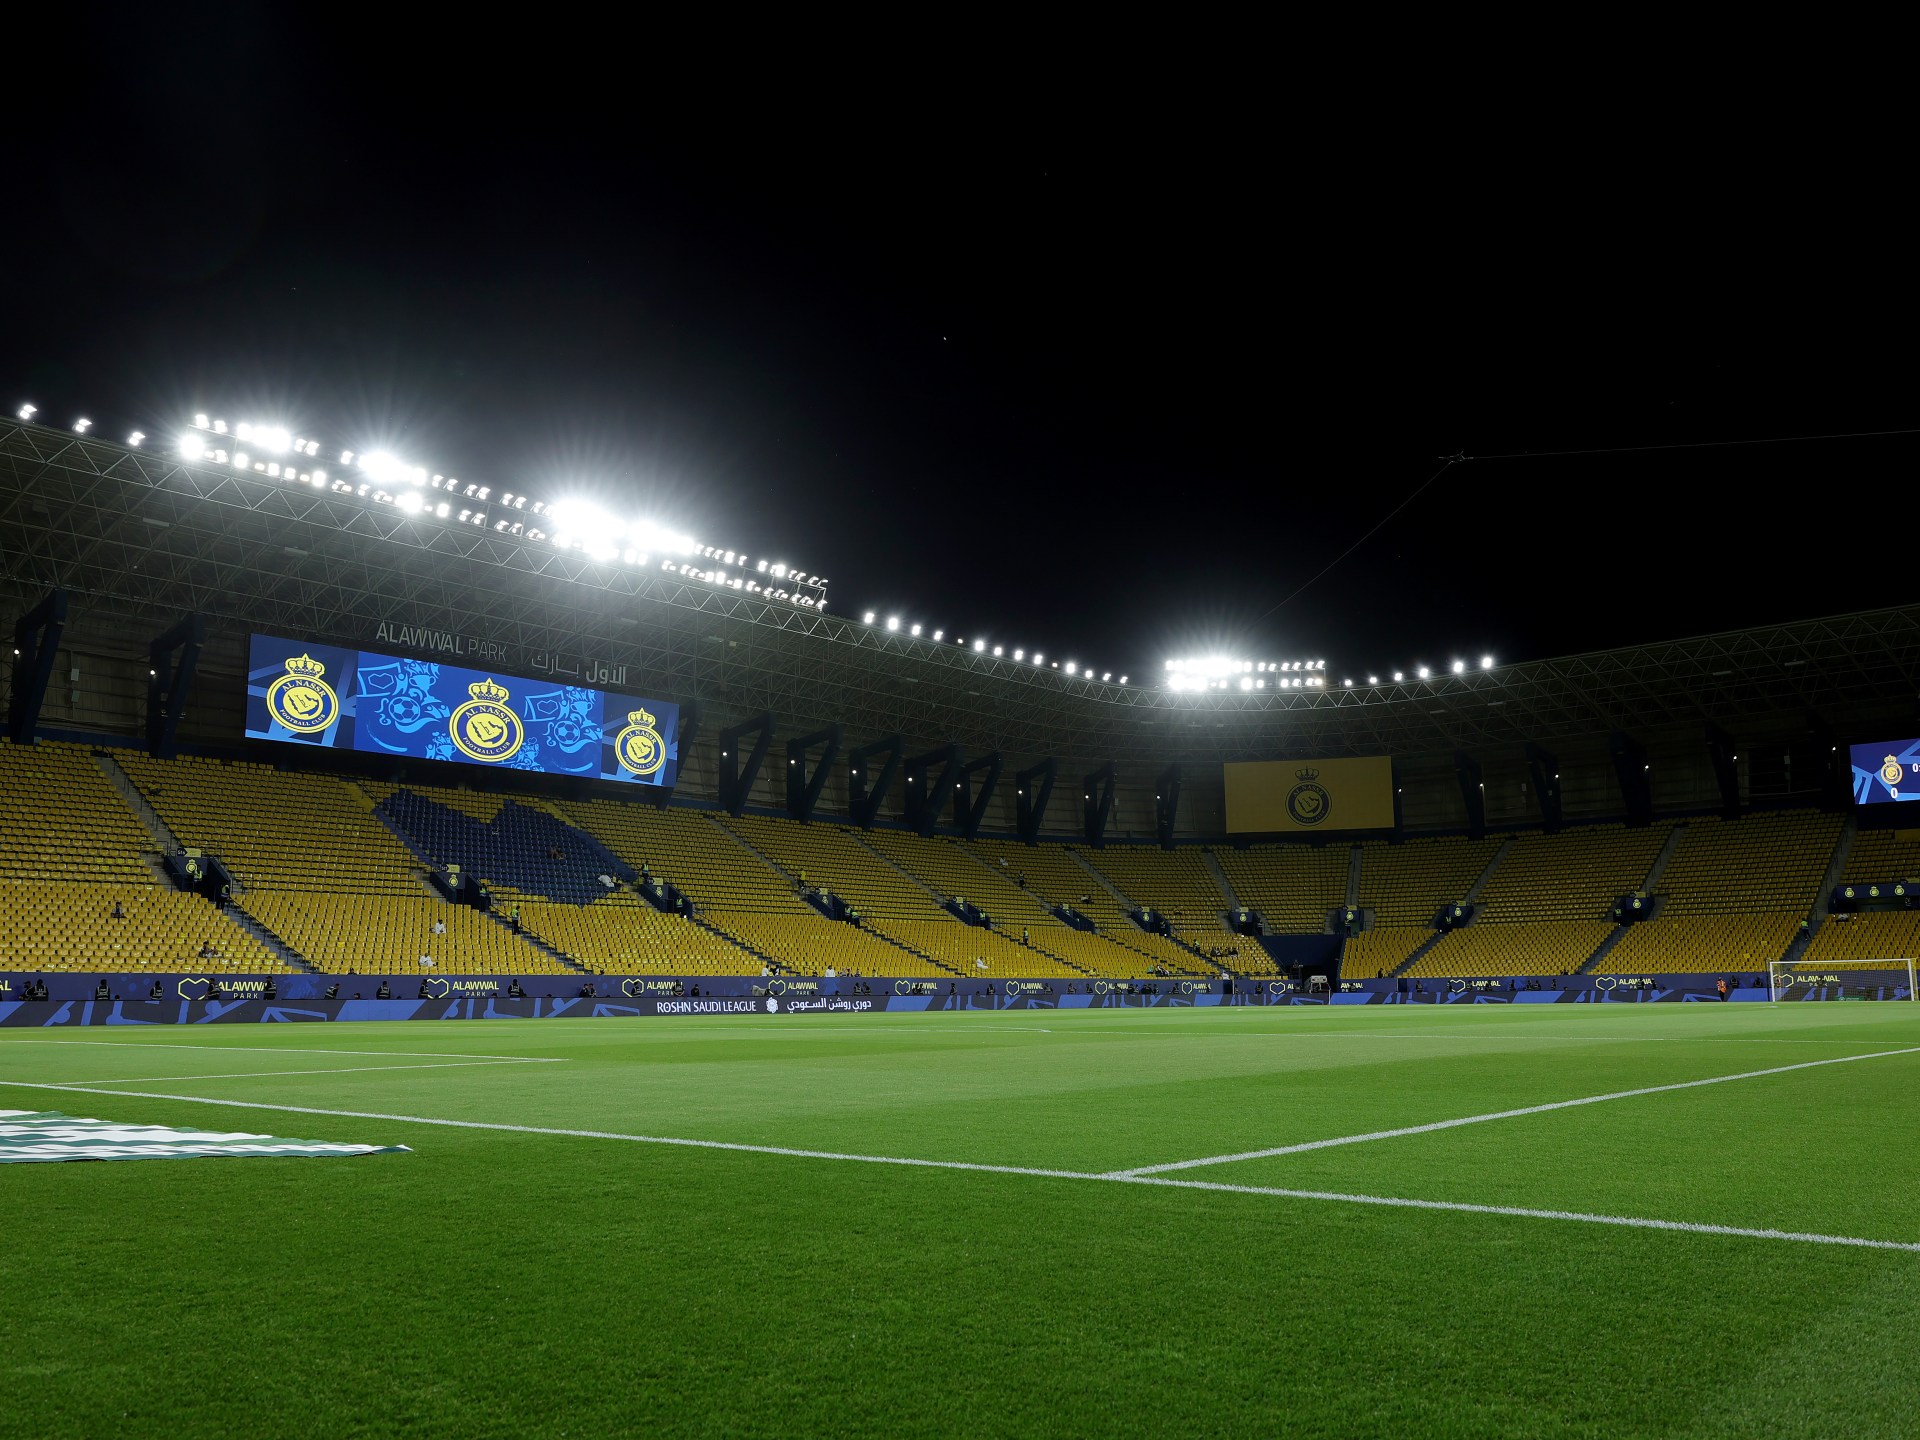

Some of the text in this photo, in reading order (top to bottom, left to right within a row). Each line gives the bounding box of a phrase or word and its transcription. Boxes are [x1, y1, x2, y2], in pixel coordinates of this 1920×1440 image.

[376, 622, 507, 662] ALAWWAL PARK
[282, 680, 326, 697] AL NASSR
[280, 709, 326, 726] FOOTBALL CLUB
[465, 706, 511, 724] AL NASSR
[626, 731, 634, 740] AL
[463, 737, 511, 754] FOOTBALL CLUB
[1890, 787, 1898, 799] 0
[452, 981, 499, 990] ALAWWAL
[788, 982, 818, 990] ALAWWAL
[657, 1001, 756, 1013] ROSHN SAUDI LEAGUE
[787, 997, 872, 1013] دوري روشن السعودي
